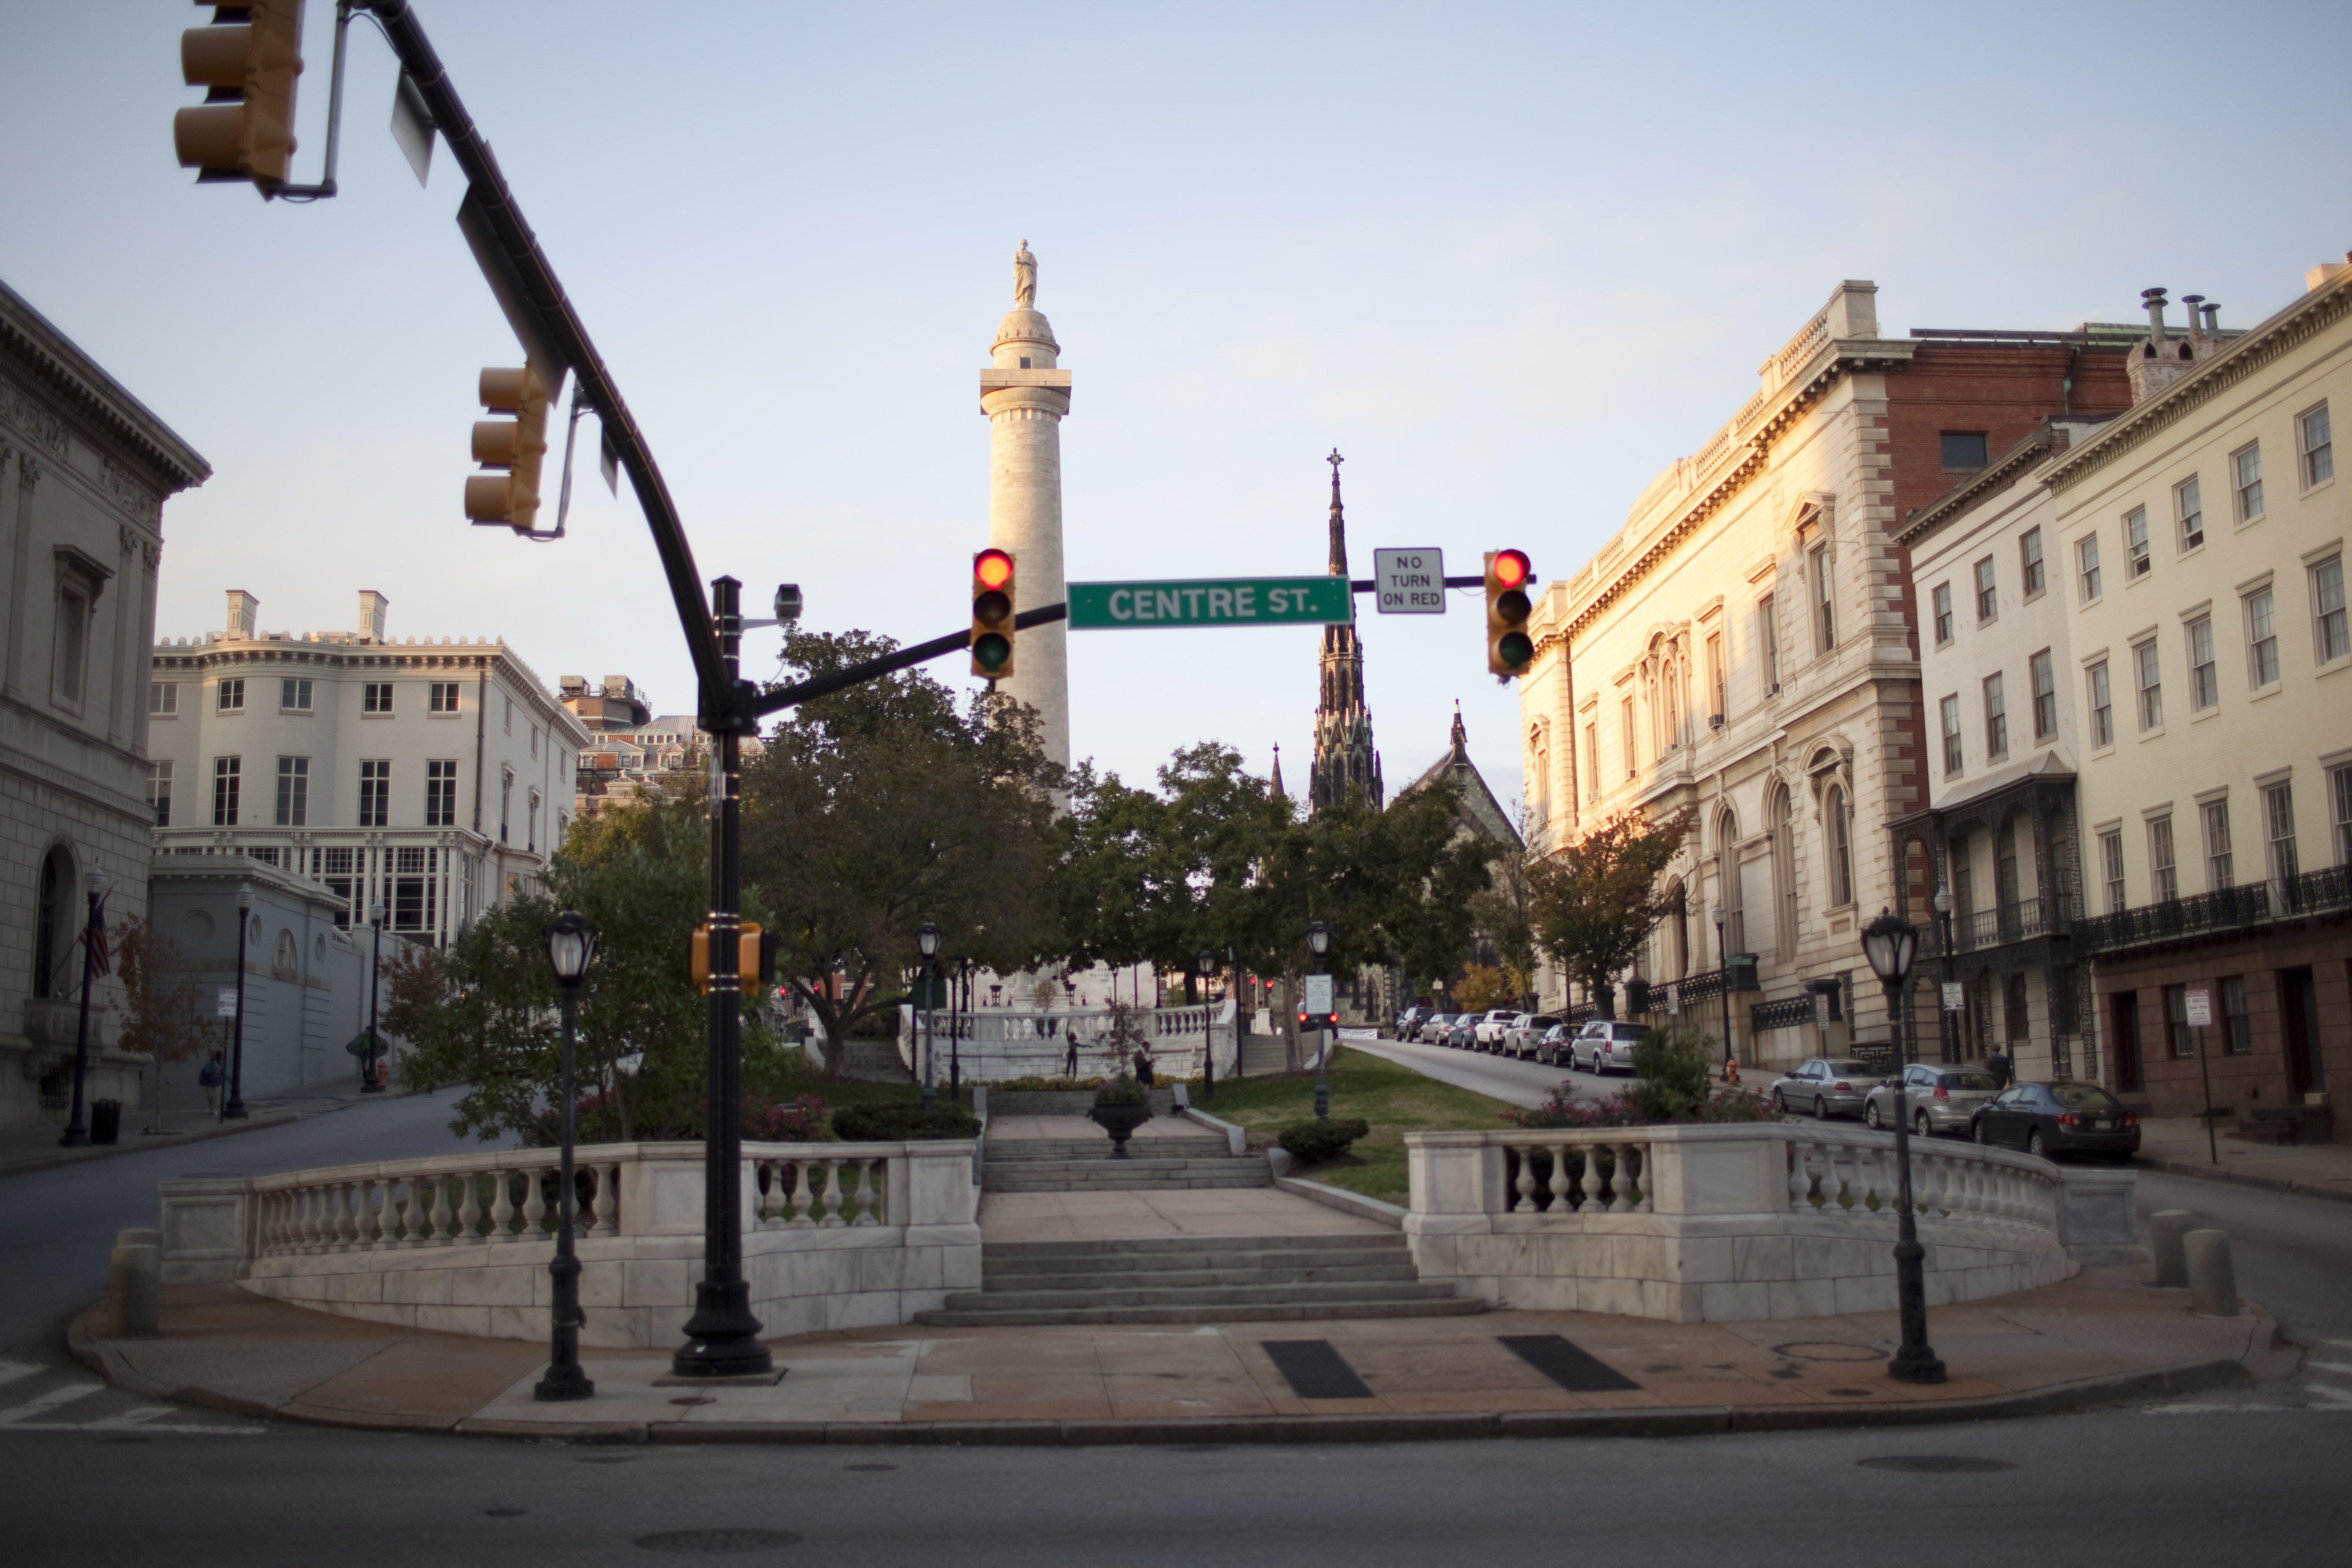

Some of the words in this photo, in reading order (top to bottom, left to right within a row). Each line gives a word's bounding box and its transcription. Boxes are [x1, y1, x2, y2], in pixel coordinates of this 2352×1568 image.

[1397, 557, 1421, 569] NO
[1390, 575, 1430, 587] TURN
[1109, 586, 1256, 620] CENTRE
[1267, 588, 1318, 614] ST.
[1384, 593, 1403, 605] ON
[1411, 593, 1440, 605] RED
